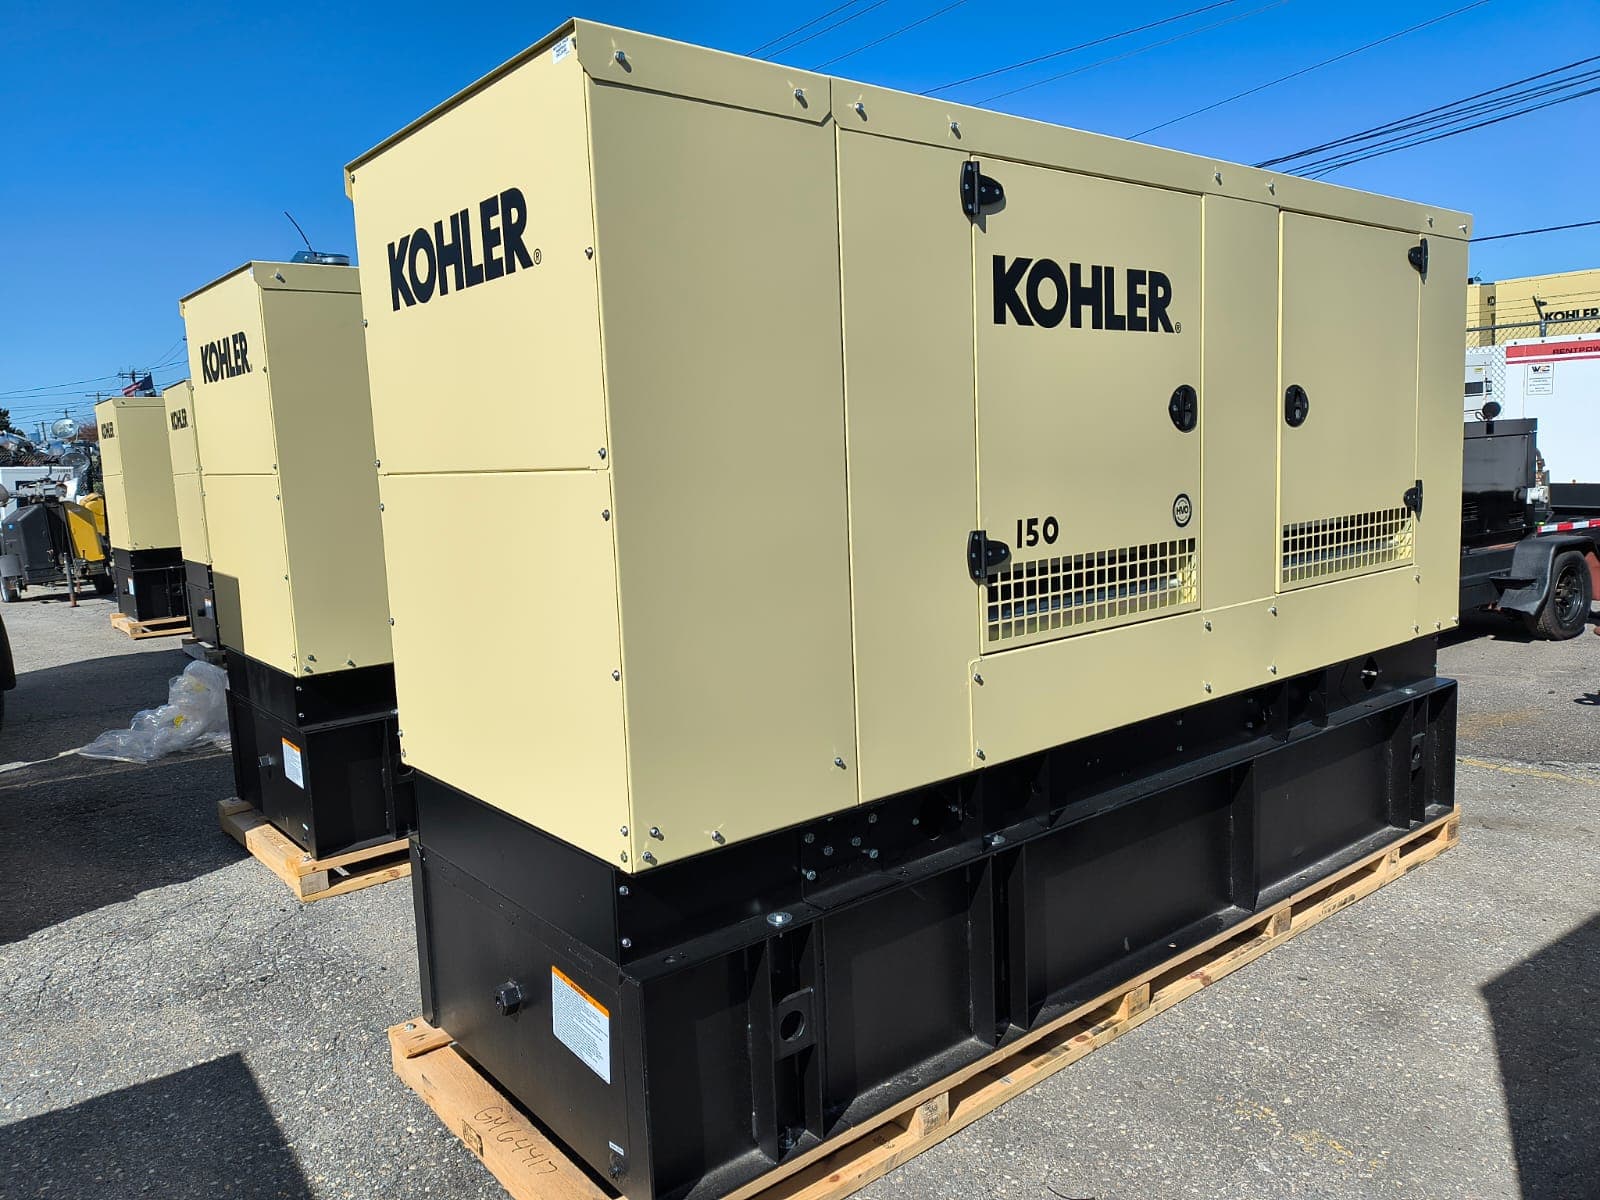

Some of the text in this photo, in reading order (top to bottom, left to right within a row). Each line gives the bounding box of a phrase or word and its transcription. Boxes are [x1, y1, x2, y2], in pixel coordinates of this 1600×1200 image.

[387, 187, 534, 312] KOHLER
[992, 254, 1175, 334] KOHLER
[200, 331, 250, 384] KOHLER
[170, 408, 188, 430] KOHLER
[1016, 515, 1059, 549] 150
[1176, 505, 1189, 516] HVO
